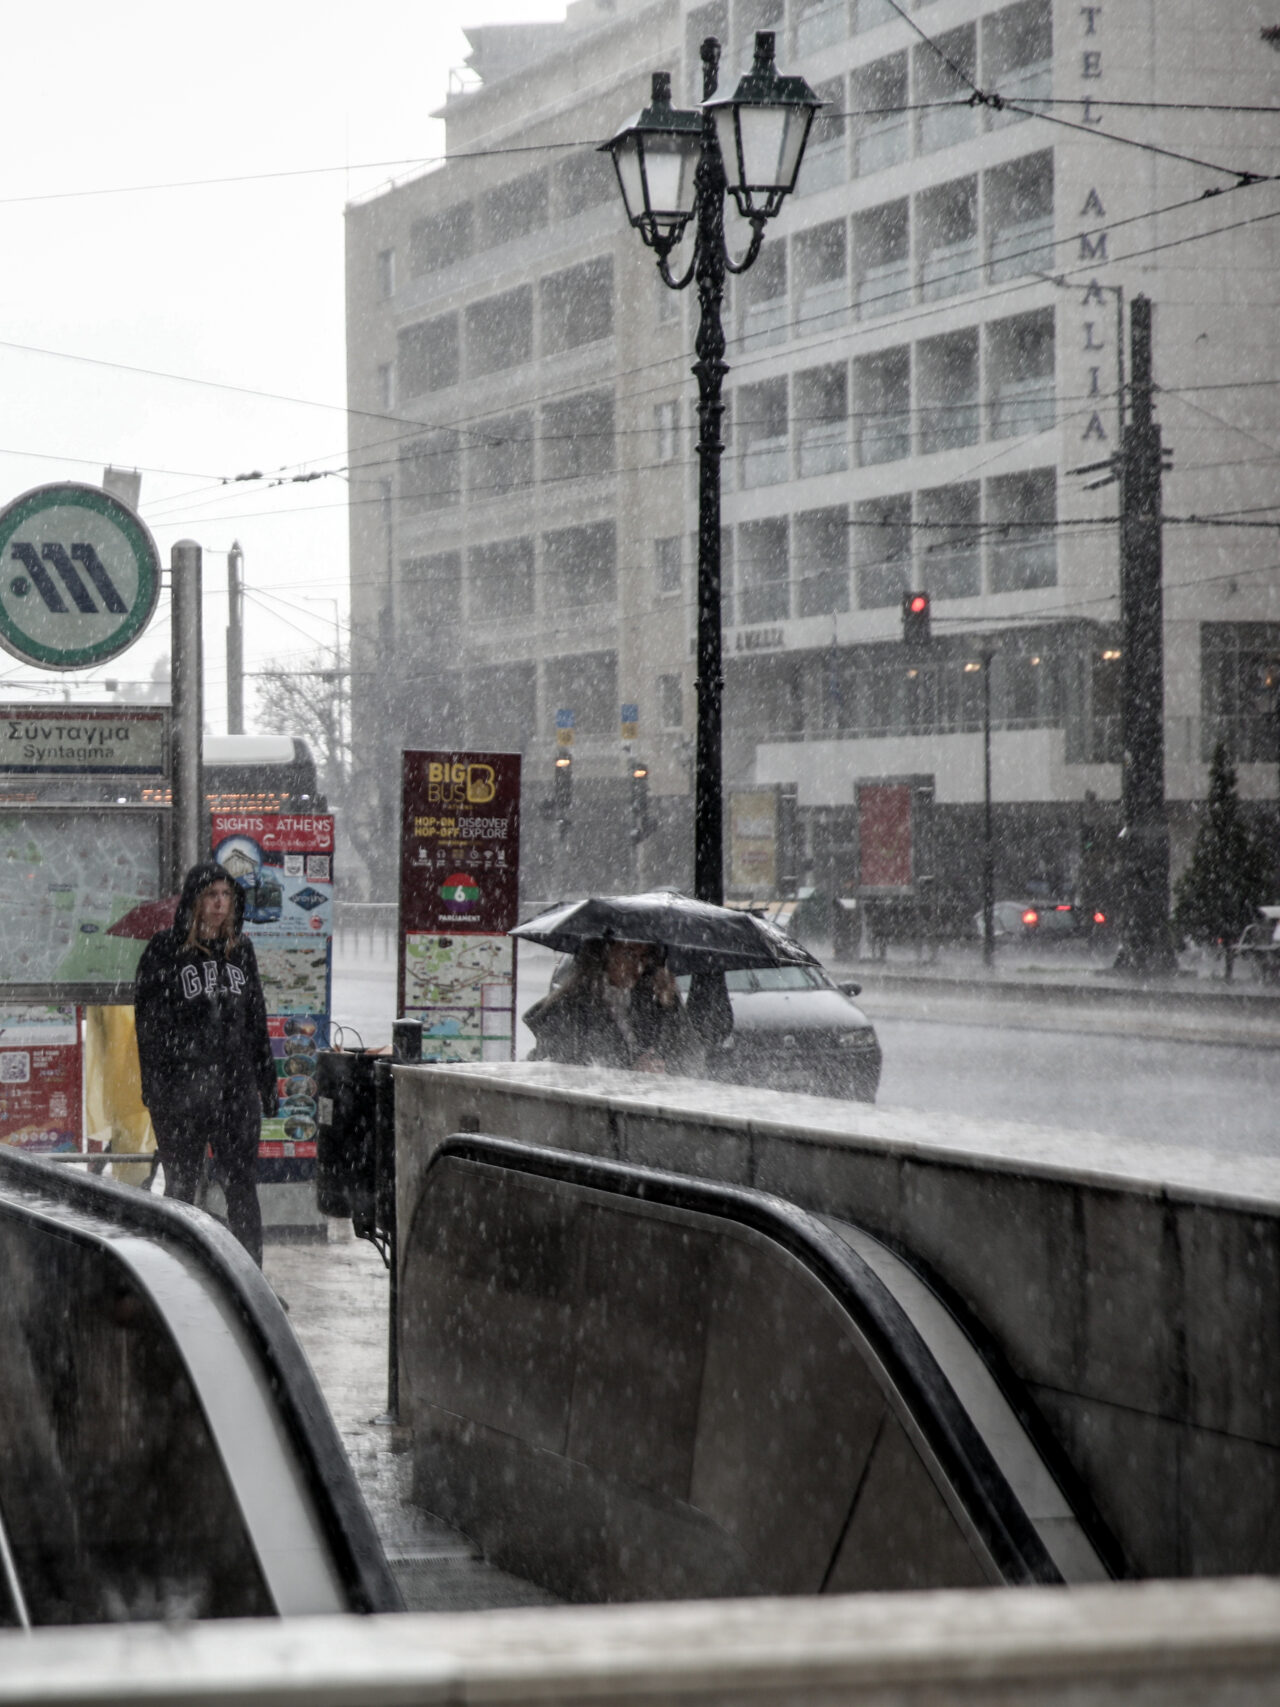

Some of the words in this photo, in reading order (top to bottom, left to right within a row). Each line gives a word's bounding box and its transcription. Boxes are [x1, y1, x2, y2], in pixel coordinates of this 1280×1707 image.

[1079, 187, 1109, 441] AMALIA
[8, 721, 130, 745] Σύνταγμα
[23, 745, 114, 760] Syntagma
[429, 762, 466, 783] BIG
[428, 783, 466, 803] BUS
[216, 818, 264, 831] SIGHTS
[276, 819, 331, 832] ATHENS
[415, 816, 455, 826] HOP-ON
[459, 817, 508, 828] DISCOVER
[415, 826, 460, 837] HOP-OFF
[462, 828, 508, 839] EXPLORE
[454, 885, 466, 903] 6
[439, 914, 481, 922] PARLIAMENT
[180, 960, 246, 1000] GAP
